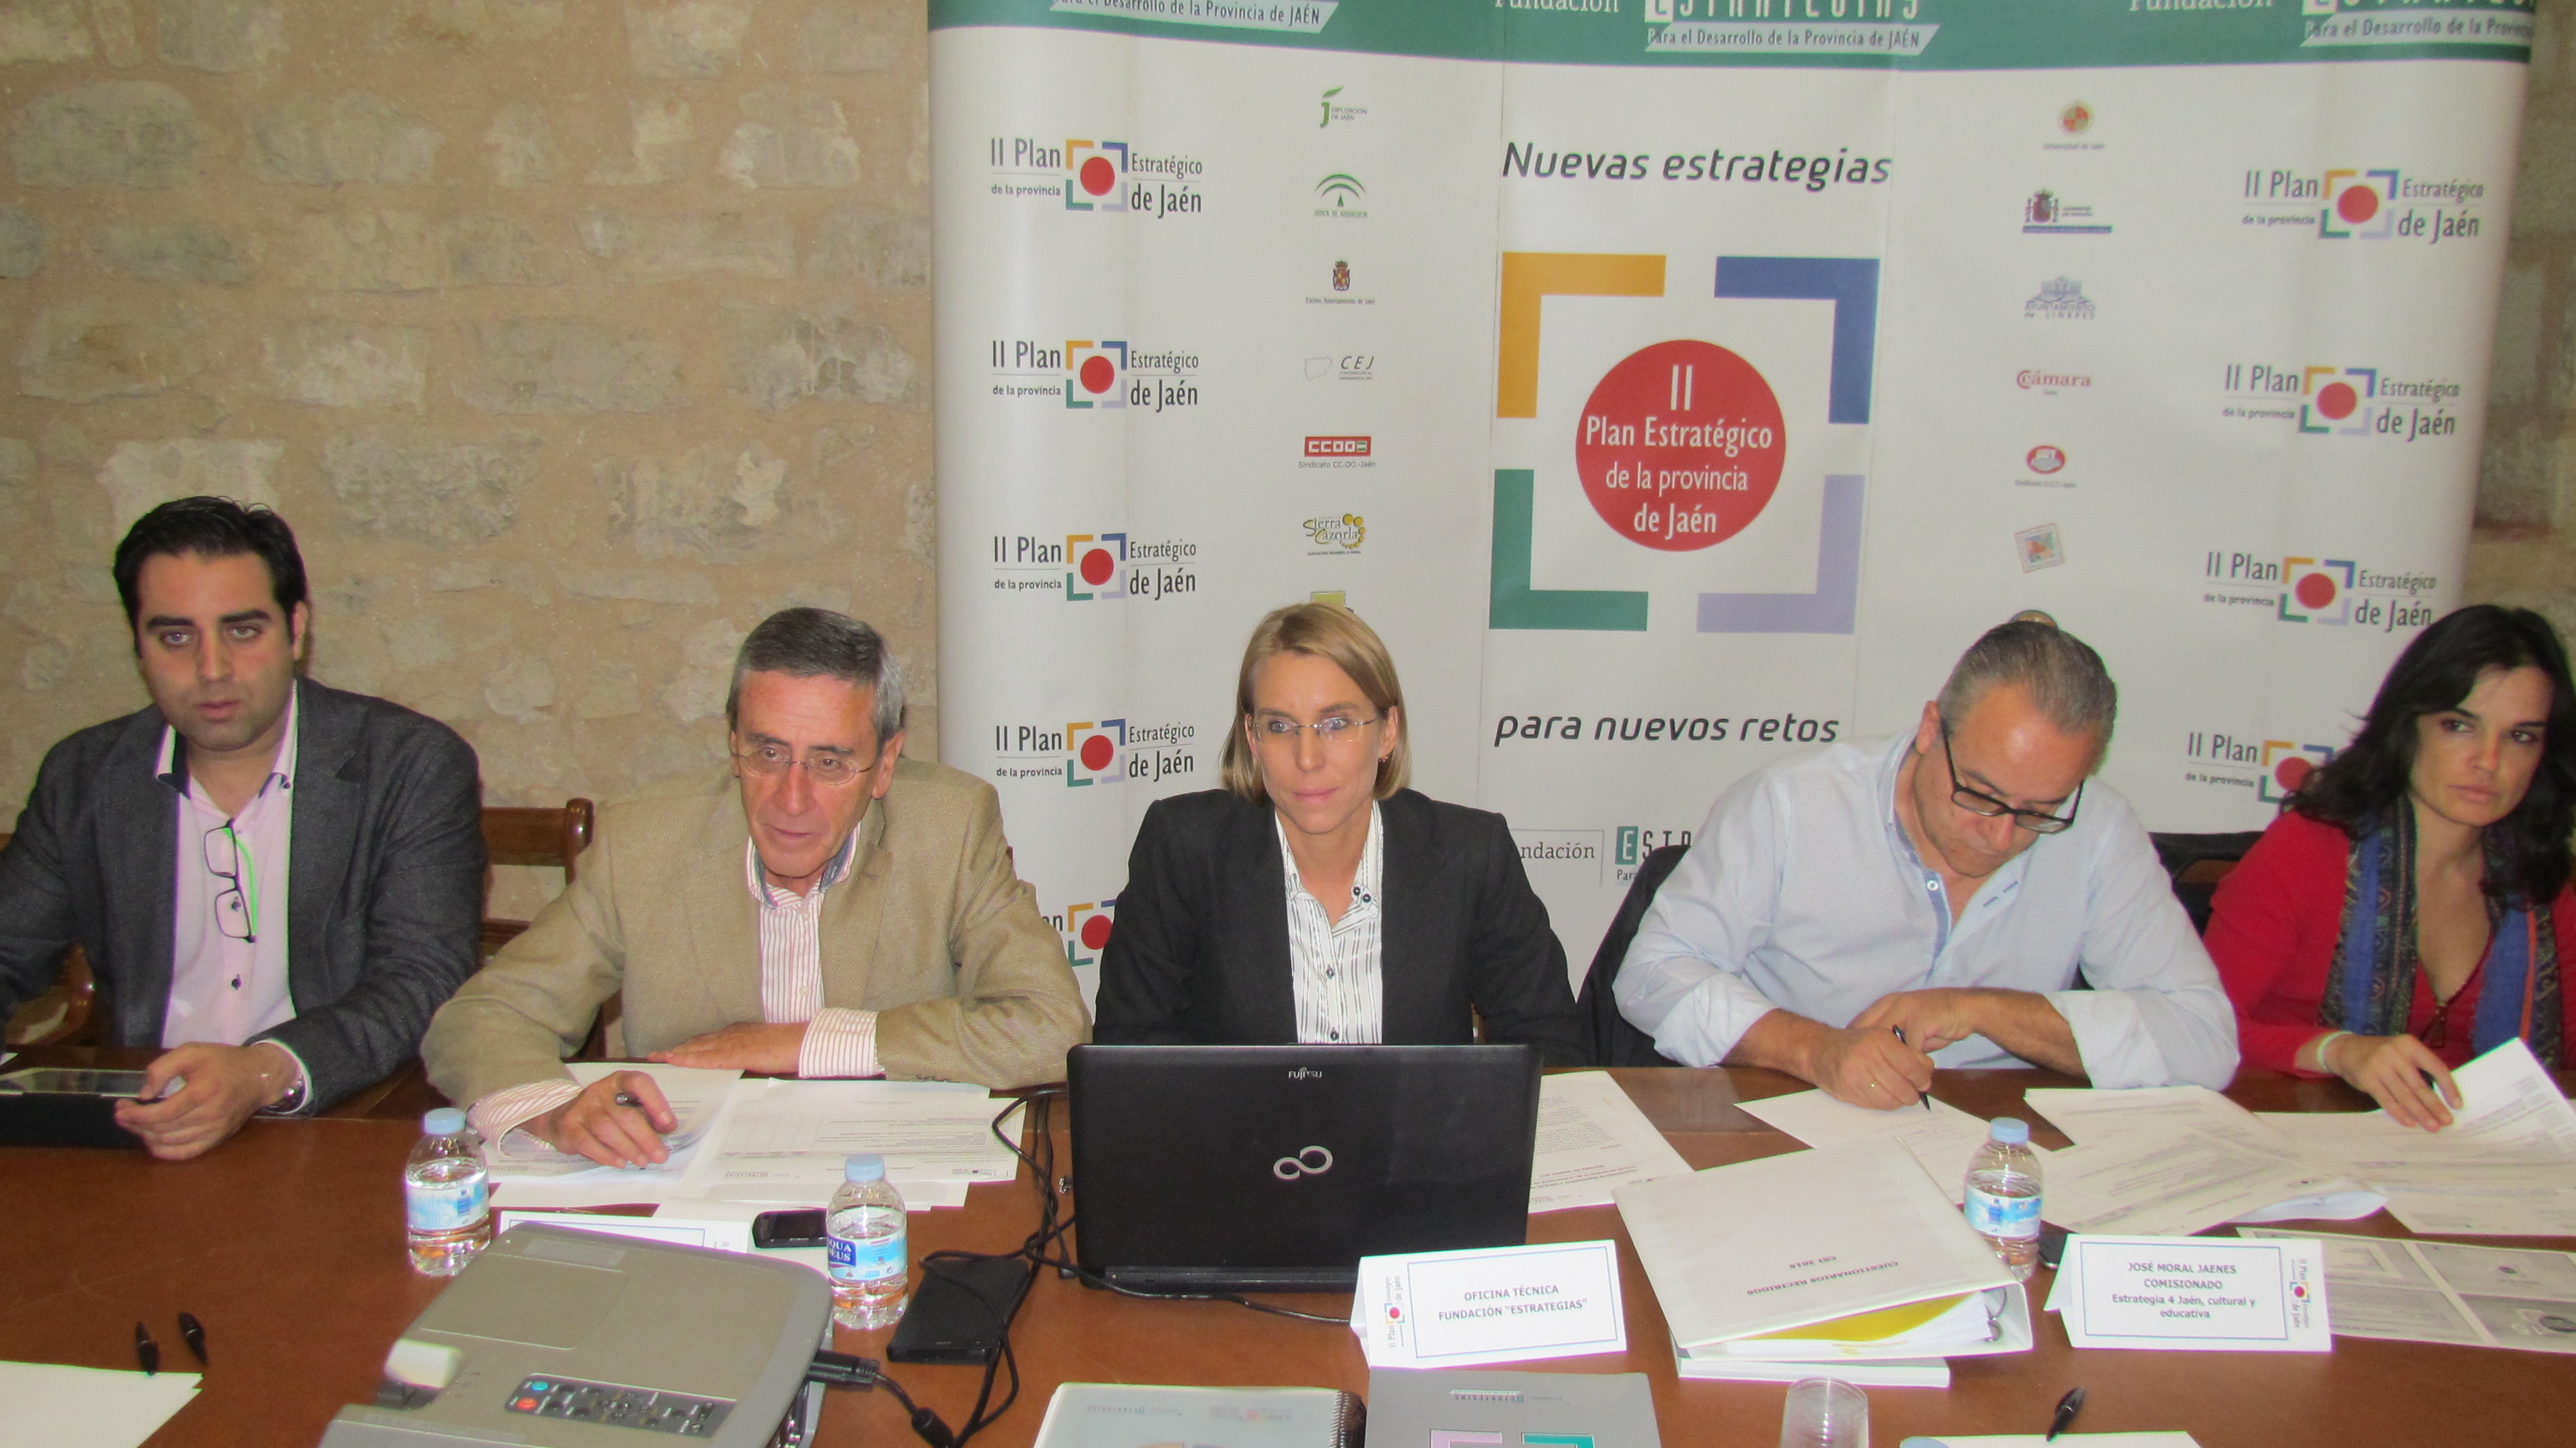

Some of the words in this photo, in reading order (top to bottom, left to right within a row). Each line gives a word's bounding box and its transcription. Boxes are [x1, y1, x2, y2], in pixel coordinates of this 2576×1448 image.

[1170, 0, 1184, 14] de
[1190, 0, 1201, 17] la
[1205, 3, 1264, 21] Provincia
[1270, 6, 1285, 23] de
[1287, 3, 1320, 27] JAÉN
[2343, 19, 2357, 36] el
[2363, 17, 2441, 35] Desarrollo
[2447, 17, 2463, 34] de
[2467, 17, 2481, 34] la
[1648, 28, 1675, 44] Para
[1682, 28, 1692, 44] el
[1697, 29, 1762, 45] Desarrollo
[1768, 30, 1782, 45] de
[1788, 30, 1799, 45] la
[1805, 30, 1863, 46] Provincia
[1869, 30, 1883, 47] de
[1887, 28, 1920, 50] JAÉN
[990, 138, 1004, 167] II
[1016, 138, 1062, 169] Plan
[1130, 153, 1203, 180] Estratégico
[1501, 142, 1649, 181] Nuevas
[1662, 148, 1893, 193] estrategias
[991, 184, 1002, 196] de
[1005, 184, 1014, 197] la
[1016, 184, 1061, 199] provincia
[2244, 171, 2260, 198] II
[2270, 171, 2319, 199] Plan
[2402, 179, 2484, 204] Estratégico
[1130, 184, 1153, 212] de
[1157, 183, 1203, 220] Jaén
[2242, 214, 2255, 226] de
[2257, 214, 2266, 226] la
[2267, 215, 2315, 228] provincia
[2397, 210, 2426, 237] de
[2429, 211, 2480, 245] Jaén
[992, 341, 1004, 368] II
[1016, 341, 1061, 369] Plan
[1130, 351, 1199, 374] Estratégico
[1341, 355, 1375, 370] CEJ
[1670, 364, 1694, 412] II
[2017, 370, 2091, 390] Cámara
[2224, 365, 2240, 392] II
[2251, 365, 2299, 394] Plan
[2380, 378, 2460, 403] Estratégico
[992, 384, 1004, 396] de
[1006, 384, 1015, 396] la
[1017, 385, 1062, 398] provincia
[1130, 379, 1152, 407] de
[1157, 379, 1199, 413] Jaén
[2222, 406, 2235, 417] de
[2236, 406, 2246, 417] la
[2248, 407, 2296, 420] provincia
[1586, 416, 1635, 447] Plan
[1644, 416, 1774, 458] Estratégico
[2376, 409, 2403, 435] de
[2407, 409, 2457, 443] Jaén
[1605, 462, 1630, 489] de
[1636, 463, 1652, 490] la
[1658, 463, 1749, 498] provincia
[1302, 518, 1341, 536] Sierra
[1633, 502, 1660, 533] de
[1665, 502, 1718, 541] Jaén
[1315, 526, 1358, 544] Cazorla
[994, 536, 1006, 563] II
[1017, 536, 1062, 564] Plan
[1130, 540, 1196, 563] Estratégico
[2205, 553, 2222, 578] II
[2230, 553, 2278, 583] Plan
[994, 578, 1005, 590] de
[1007, 578, 1015, 590] la
[1018, 578, 1062, 592] provincia
[1129, 568, 1150, 595] de
[1155, 568, 1196, 601] Jaén
[2358, 570, 2438, 594] Estratégico
[2204, 593, 2216, 604] de
[2218, 593, 2226, 604] la
[2228, 594, 2275, 608] provincia
[2354, 600, 2381, 626] de
[2385, 599, 2433, 634] Jaén
[996, 725, 1008, 752] II
[1018, 725, 1062, 753] Plan
[1129, 723, 1195, 745] Estratégico
[1494, 714, 1582, 747] para
[1593, 715, 1730, 742] nuevos
[1739, 712, 1840, 744] retos
[2187, 732, 2203, 757] II
[2212, 734, 2259, 765] Plan
[996, 767, 1007, 778] de
[1009, 766, 1018, 778] la
[1020, 766, 1063, 780] provincia
[1128, 750, 1148, 778] de
[1155, 749, 1194, 782] Jaén
[2185, 772, 2197, 783] de
[2198, 773, 2208, 784] la
[2209, 774, 2255, 788] provincia
[1520, 841, 1596, 860] ndación
[1288, 1067, 1322, 1080] FUJITSU
[1818, 1255, 1836, 1264] CSI
[2127, 1260, 2154, 1273] JOSÉ
[2156, 1263, 2194, 1274] MORAL
[2196, 1263, 2237, 1275] JAENES
[1393, 1275, 1404, 1290] Jaén
[1810, 1261, 1898, 1284] CUESTIONARIOS
[2299, 1266, 2308, 1281] Plan
[1463, 1288, 1510, 1301] OFICINA
[1512, 1283, 1559, 1297] TÉCNICA
[1746, 1279, 1808, 1295] RECIBIDOS
[2143, 1278, 2223, 1290] COMISIONADO
[1394, 1292, 1402, 1301] de
[2112, 1292, 2165, 1306] Estrategia
[2167, 1295, 2175, 1306] 4
[2178, 1295, 2204, 1308] Jaén,
[2207, 1295, 2246, 1308] cultural
[2249, 1299, 2256, 1308] y
[1438, 1306, 1502, 1322] FUNDACIÓN
[2160, 1306, 2211, 1319] educativa
[1387, 1325, 1396, 1341] Plan
